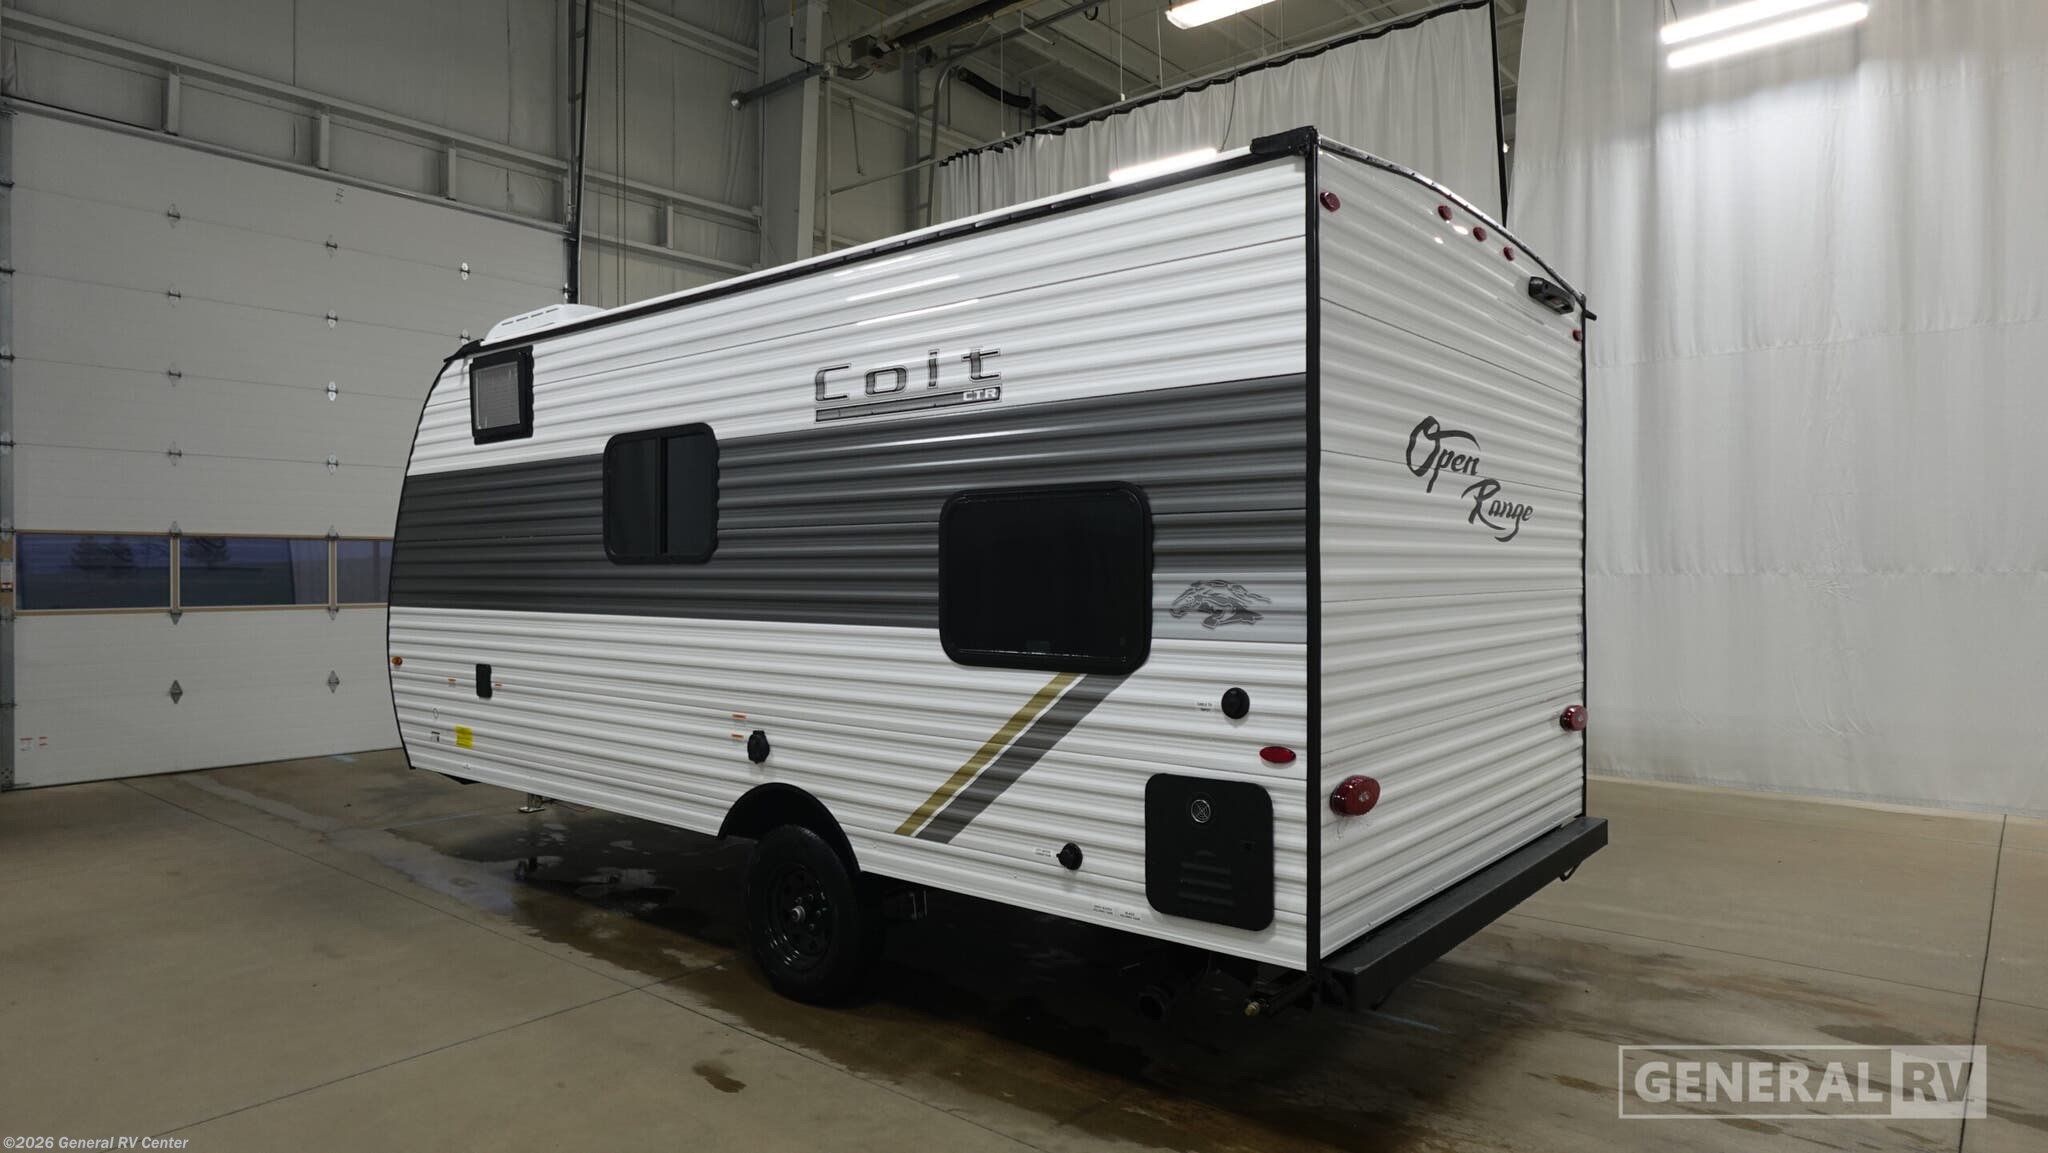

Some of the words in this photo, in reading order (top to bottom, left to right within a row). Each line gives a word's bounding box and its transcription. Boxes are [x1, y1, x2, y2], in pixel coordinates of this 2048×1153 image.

[962, 387, 997, 401] CTR
[1406, 415, 1480, 493] Open
[1461, 478, 1534, 542] Range
